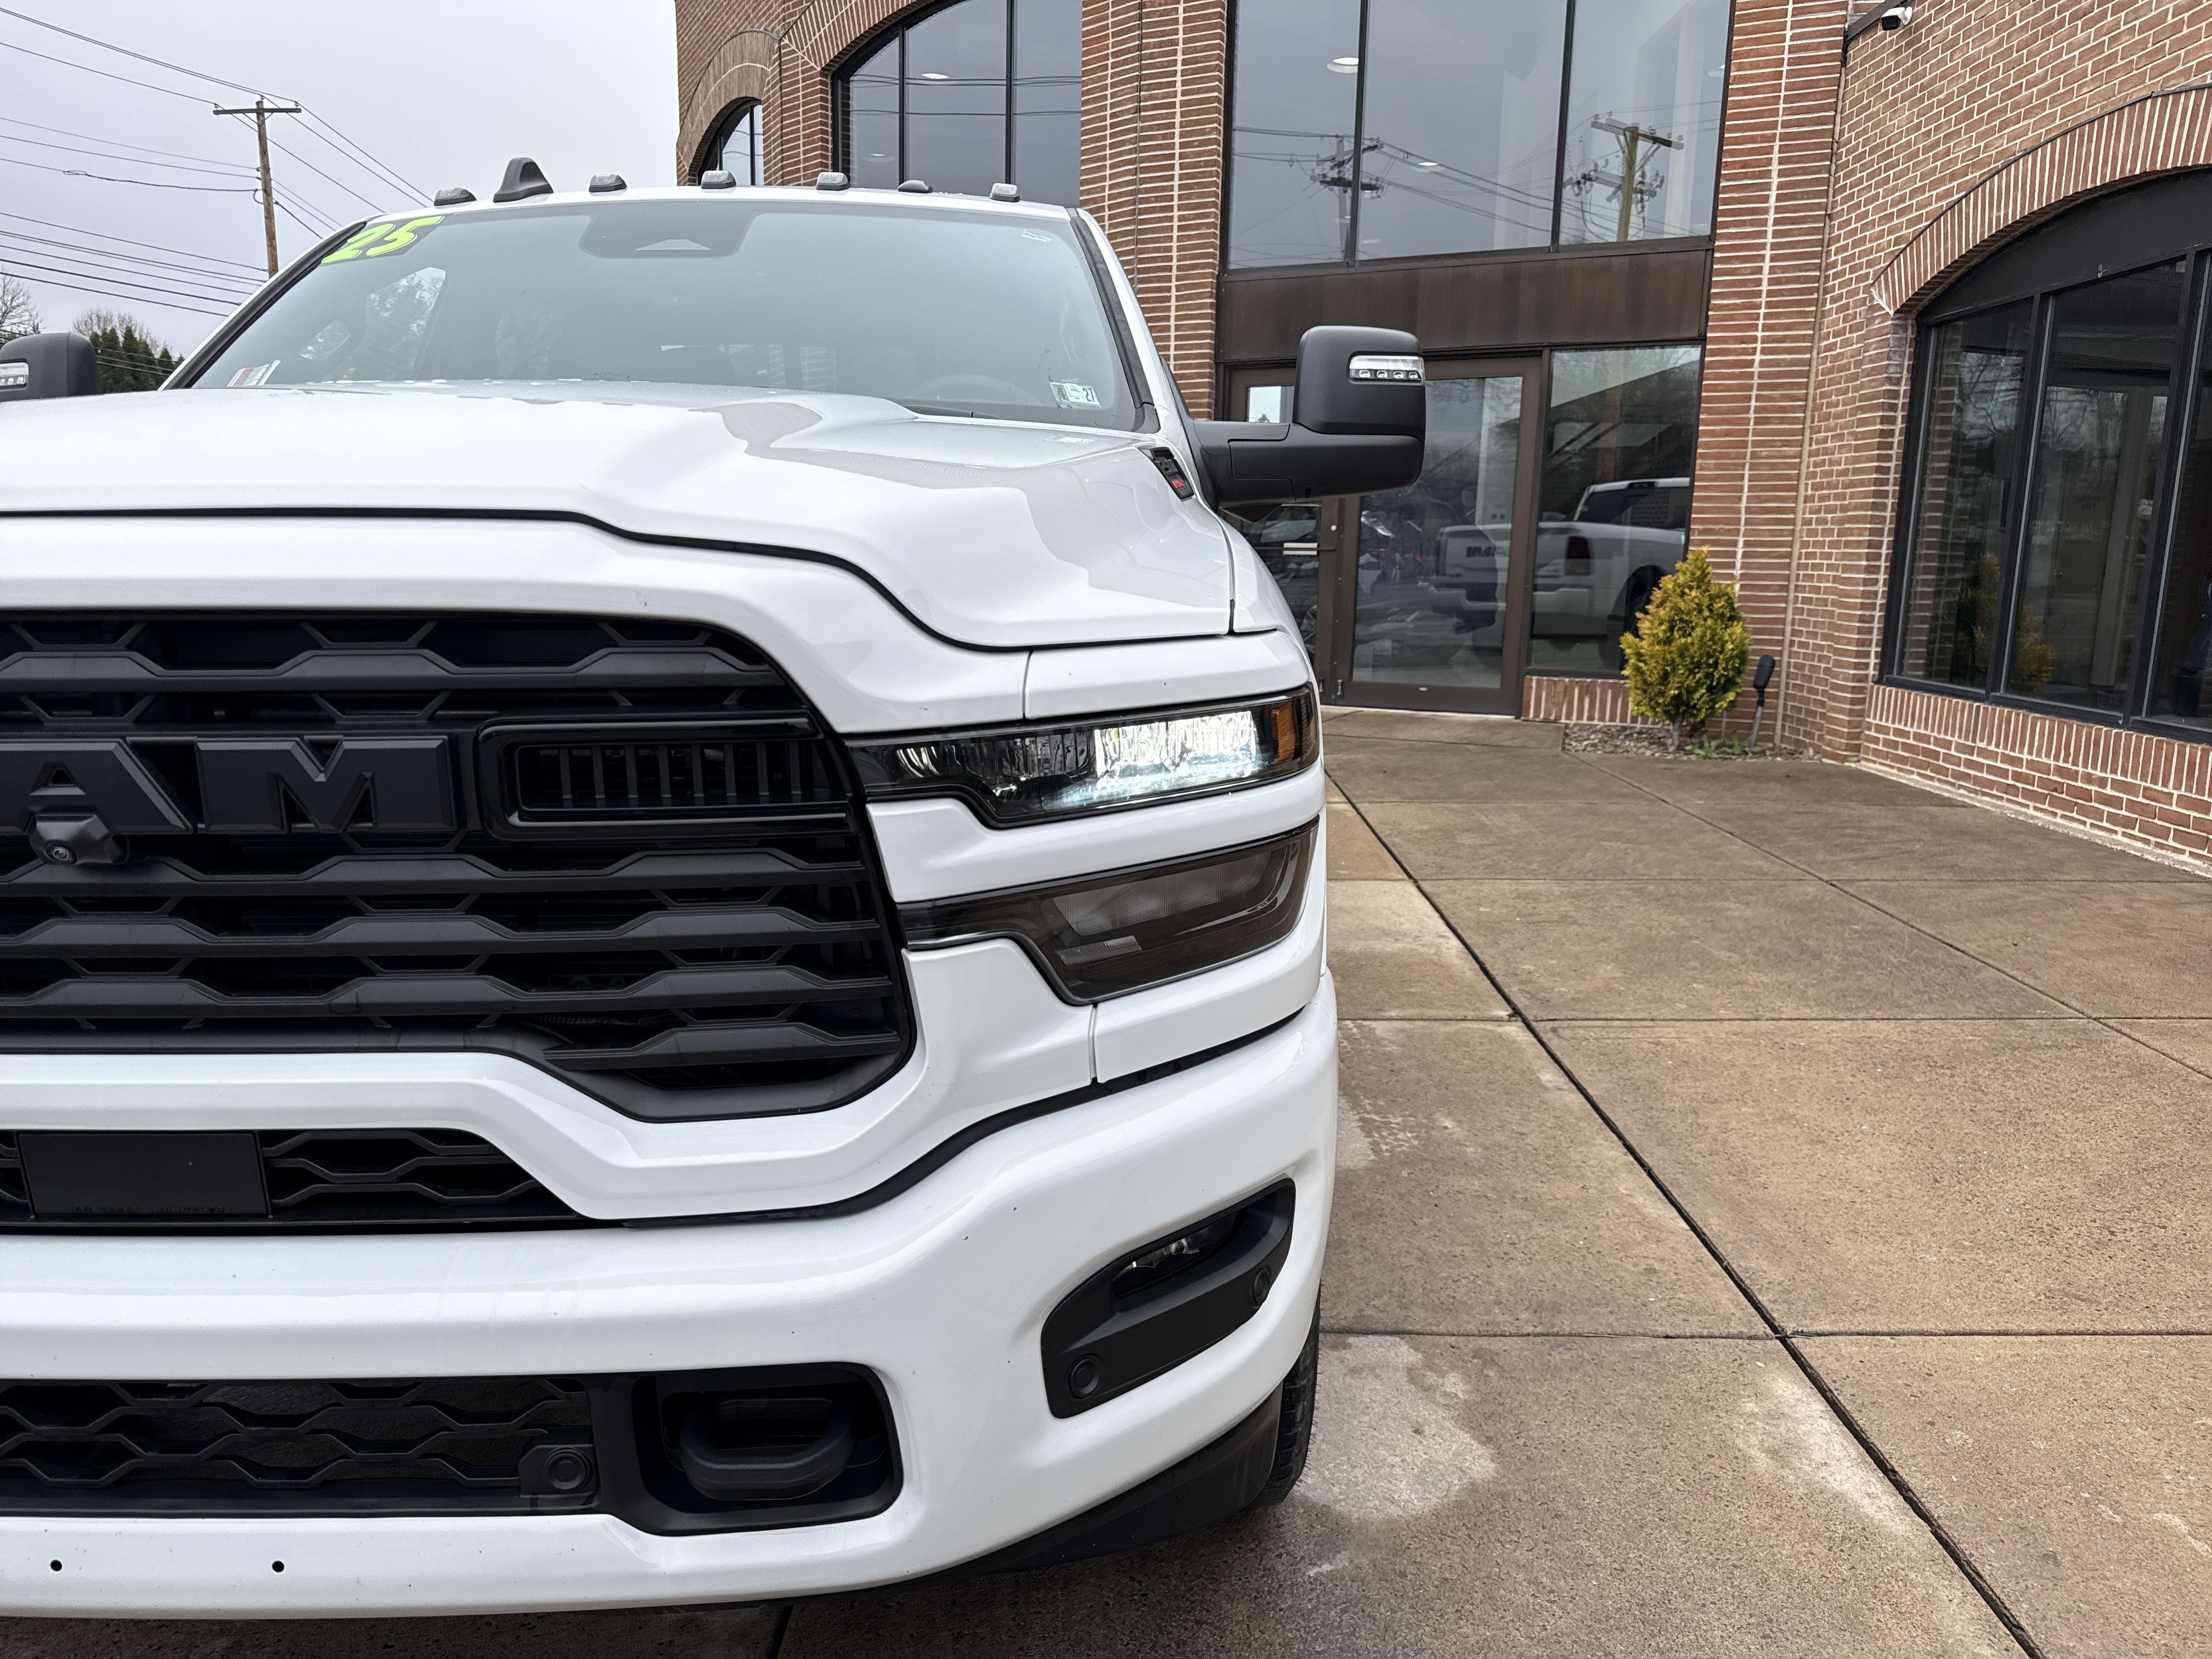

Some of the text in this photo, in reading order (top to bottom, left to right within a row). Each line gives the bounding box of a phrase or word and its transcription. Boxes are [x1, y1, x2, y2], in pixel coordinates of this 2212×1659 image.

[320, 216, 445, 264] 25
[1082, 387, 1095, 403] 27
[0, 736, 459, 833] AM
